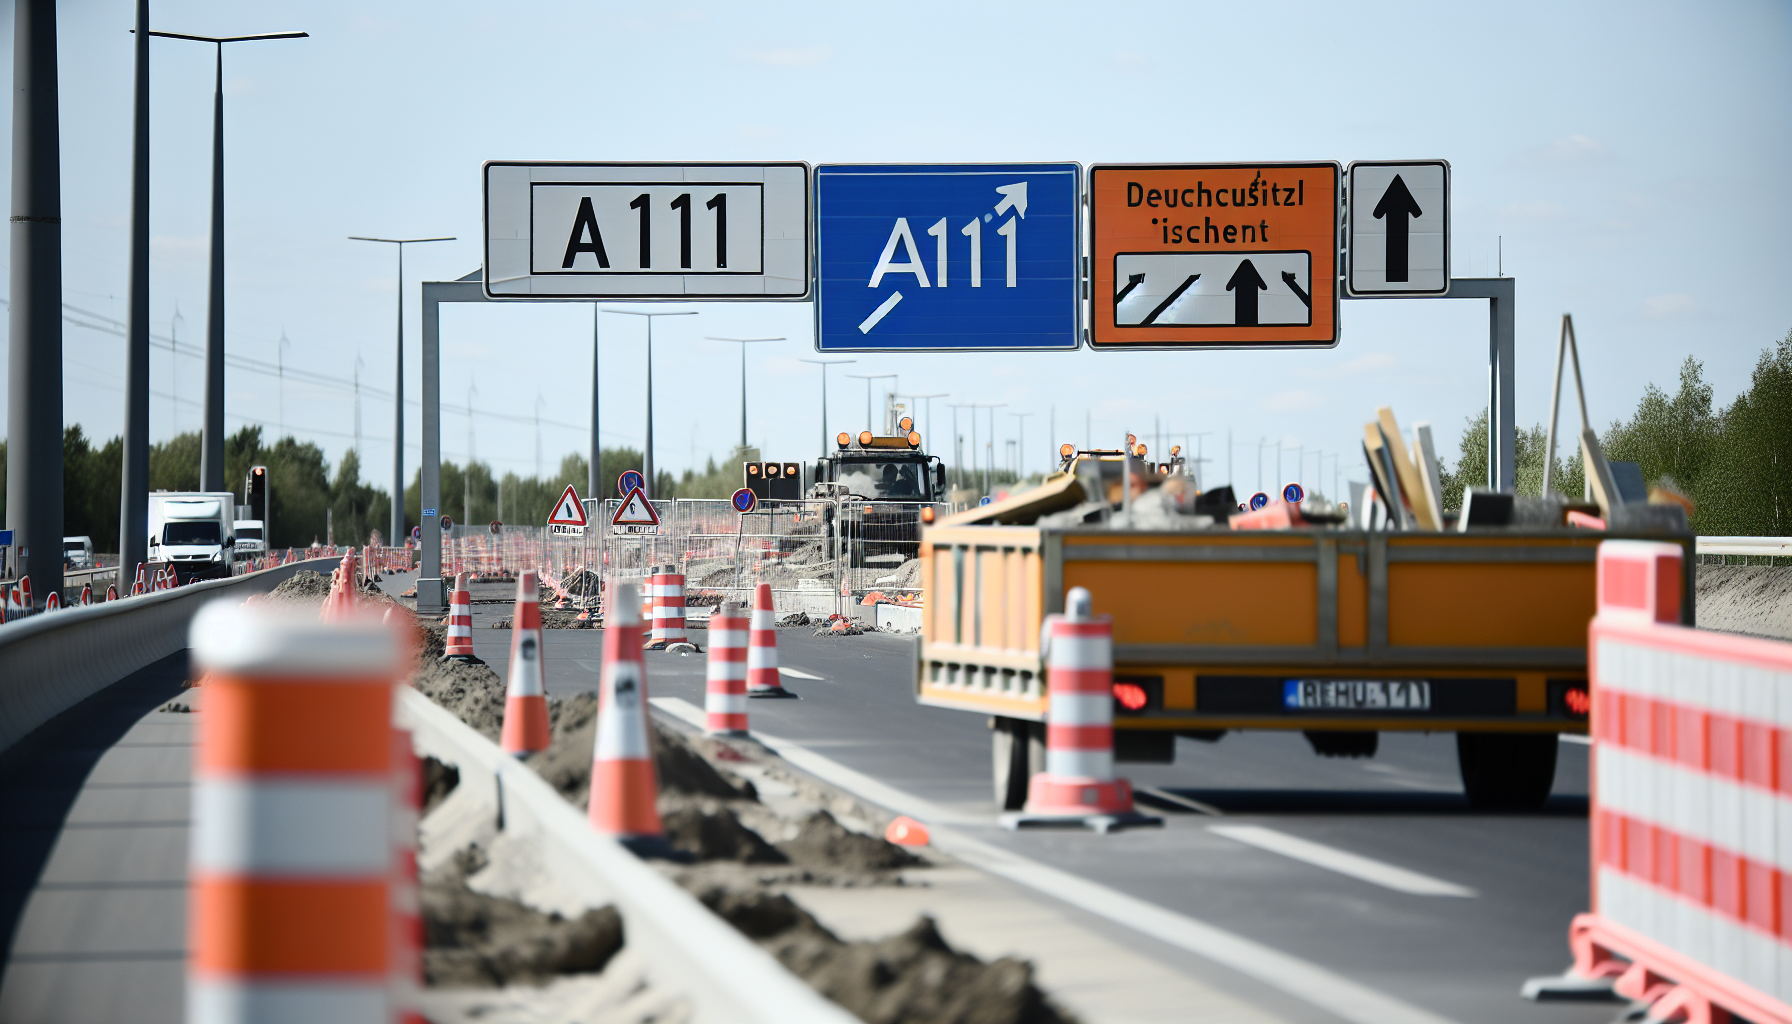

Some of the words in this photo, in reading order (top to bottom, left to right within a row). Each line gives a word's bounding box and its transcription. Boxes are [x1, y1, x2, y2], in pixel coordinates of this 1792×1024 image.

[561, 196, 611, 269] A
[629, 193, 727, 269] 111
[867, 215, 1017, 288] A111
